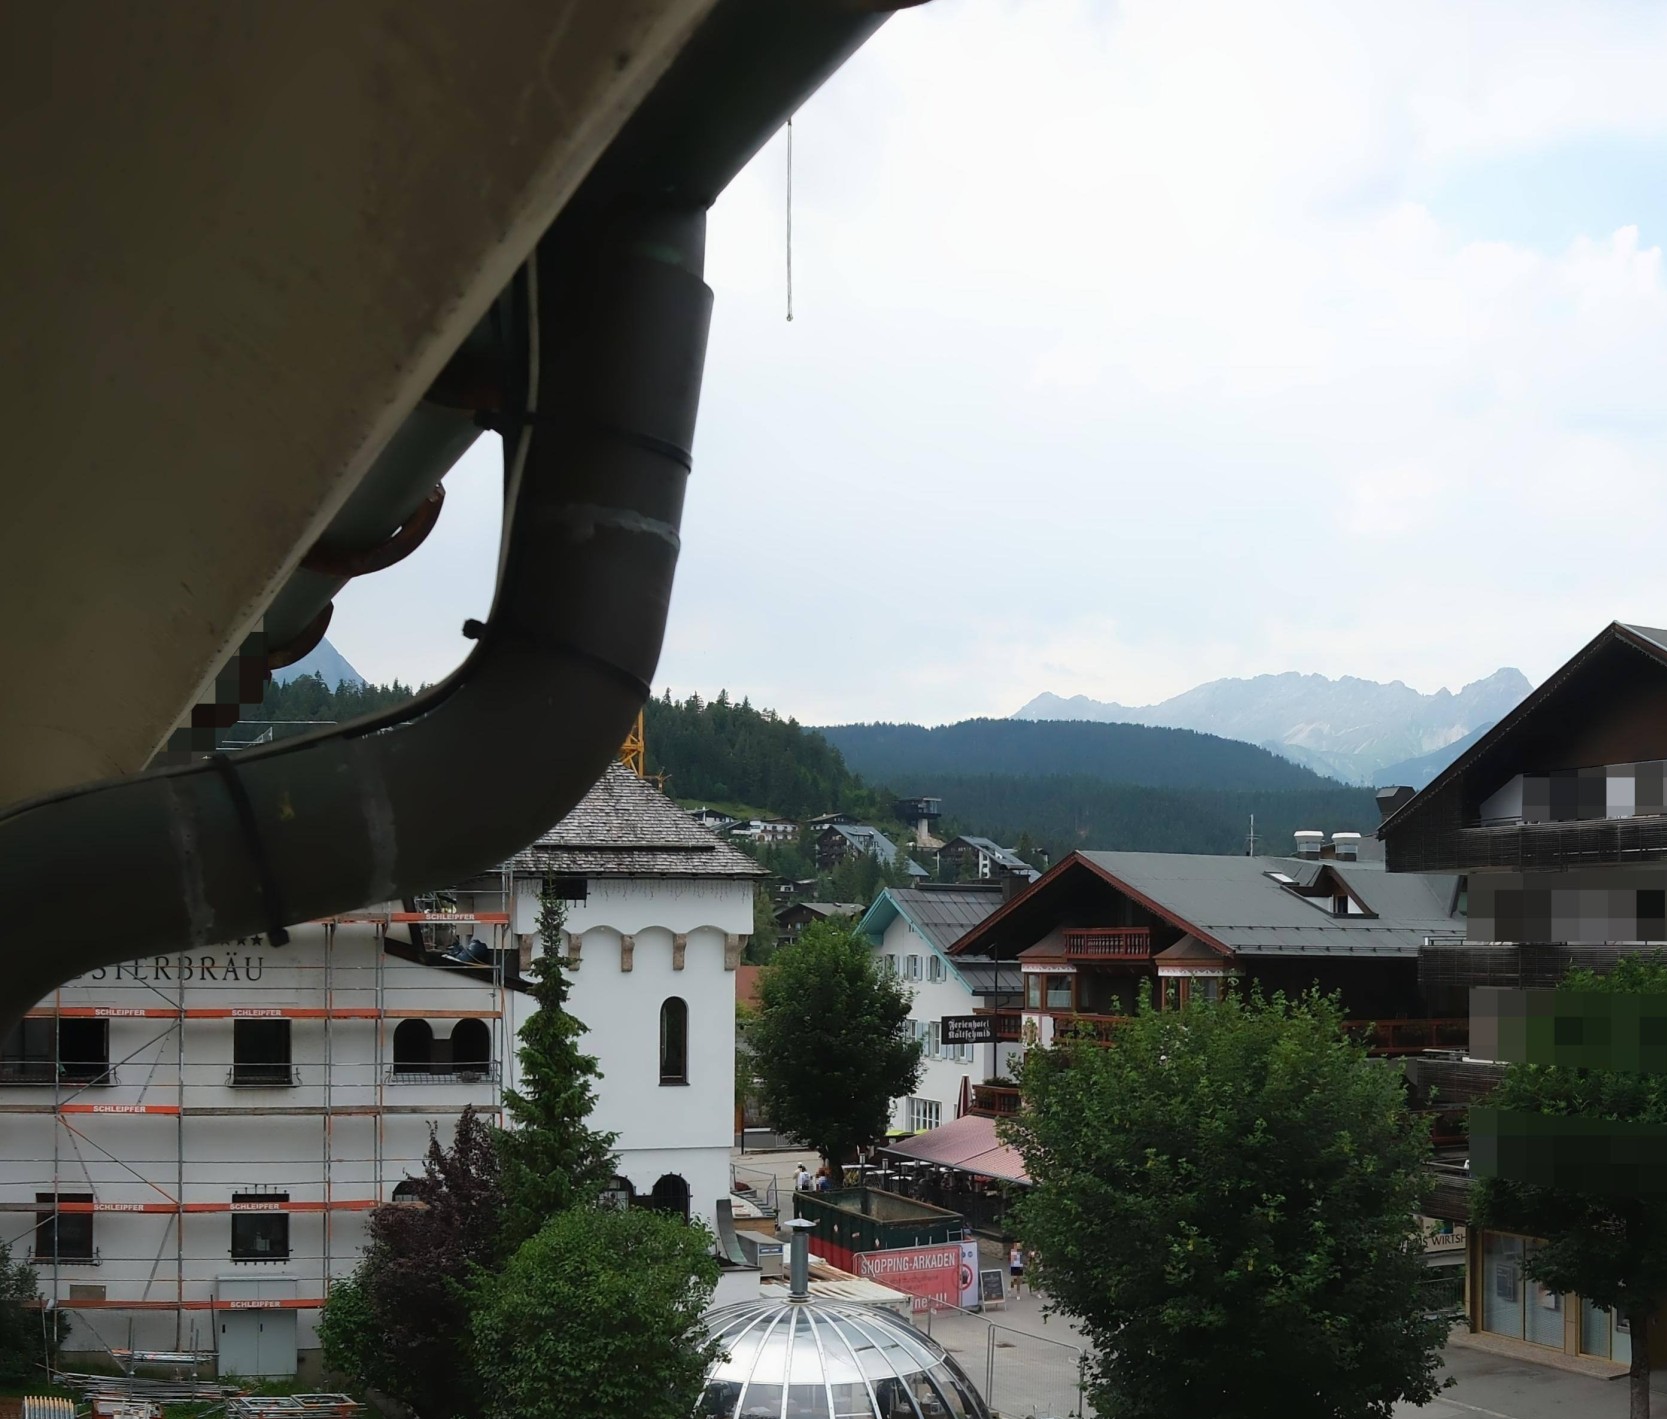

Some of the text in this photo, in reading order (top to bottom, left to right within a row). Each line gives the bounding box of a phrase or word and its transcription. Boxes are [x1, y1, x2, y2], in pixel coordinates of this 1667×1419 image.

[70, 952, 264, 981] STERBRÄU
[95, 1008, 146, 1017] SCHLEIPFER
[231, 1009, 282, 1017] SCHLEIPFER
[93, 1105, 146, 1113] SCHLEIPFER
[94, 1203, 144, 1212] SCHLEIPFER
[230, 1202, 280, 1210] SCHLEIPFER
[860, 1252, 956, 1276] SHOPPING-ARKADEN
[230, 1300, 281, 1308] SCHLEIPFER
